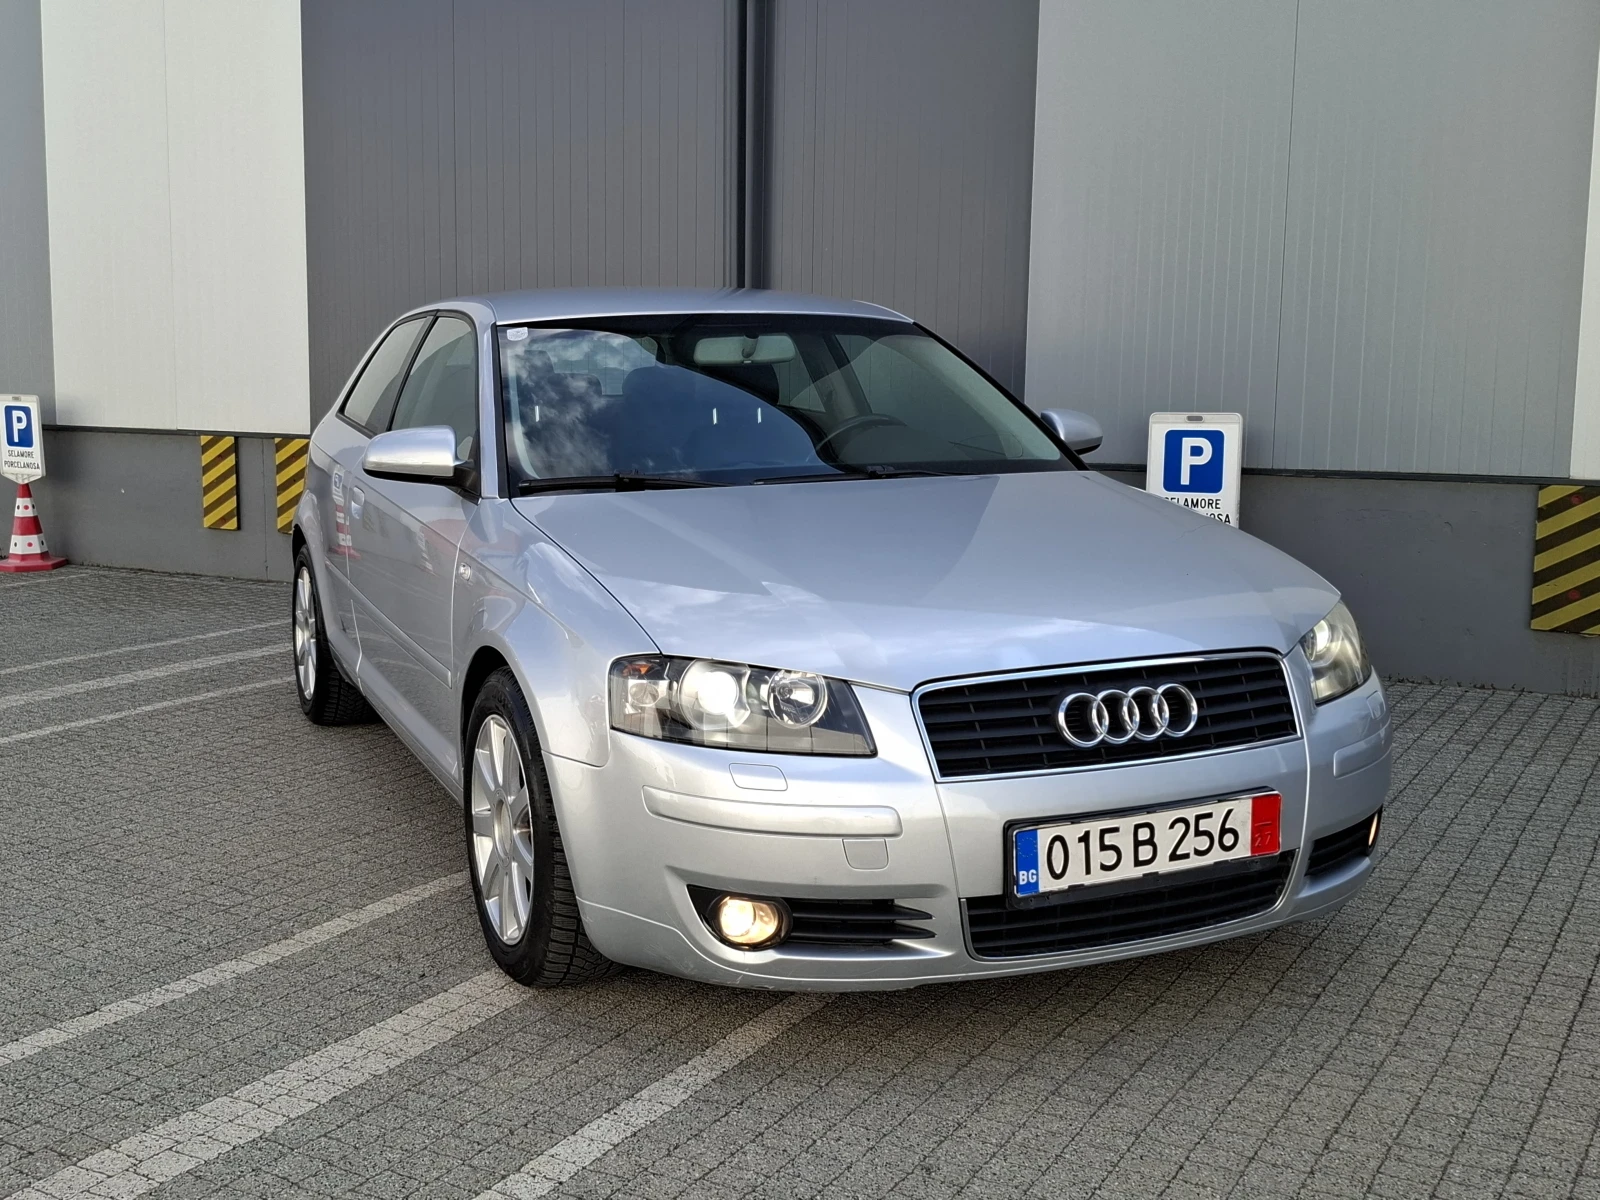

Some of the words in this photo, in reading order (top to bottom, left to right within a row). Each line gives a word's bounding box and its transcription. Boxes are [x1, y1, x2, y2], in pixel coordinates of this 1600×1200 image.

[12, 410, 27, 442] P
[8, 449, 34, 458] SELAMORE
[1180, 437, 1213, 485] P
[4, 460, 40, 470] PORCELANOSA
[1019, 869, 1037, 885] BG
